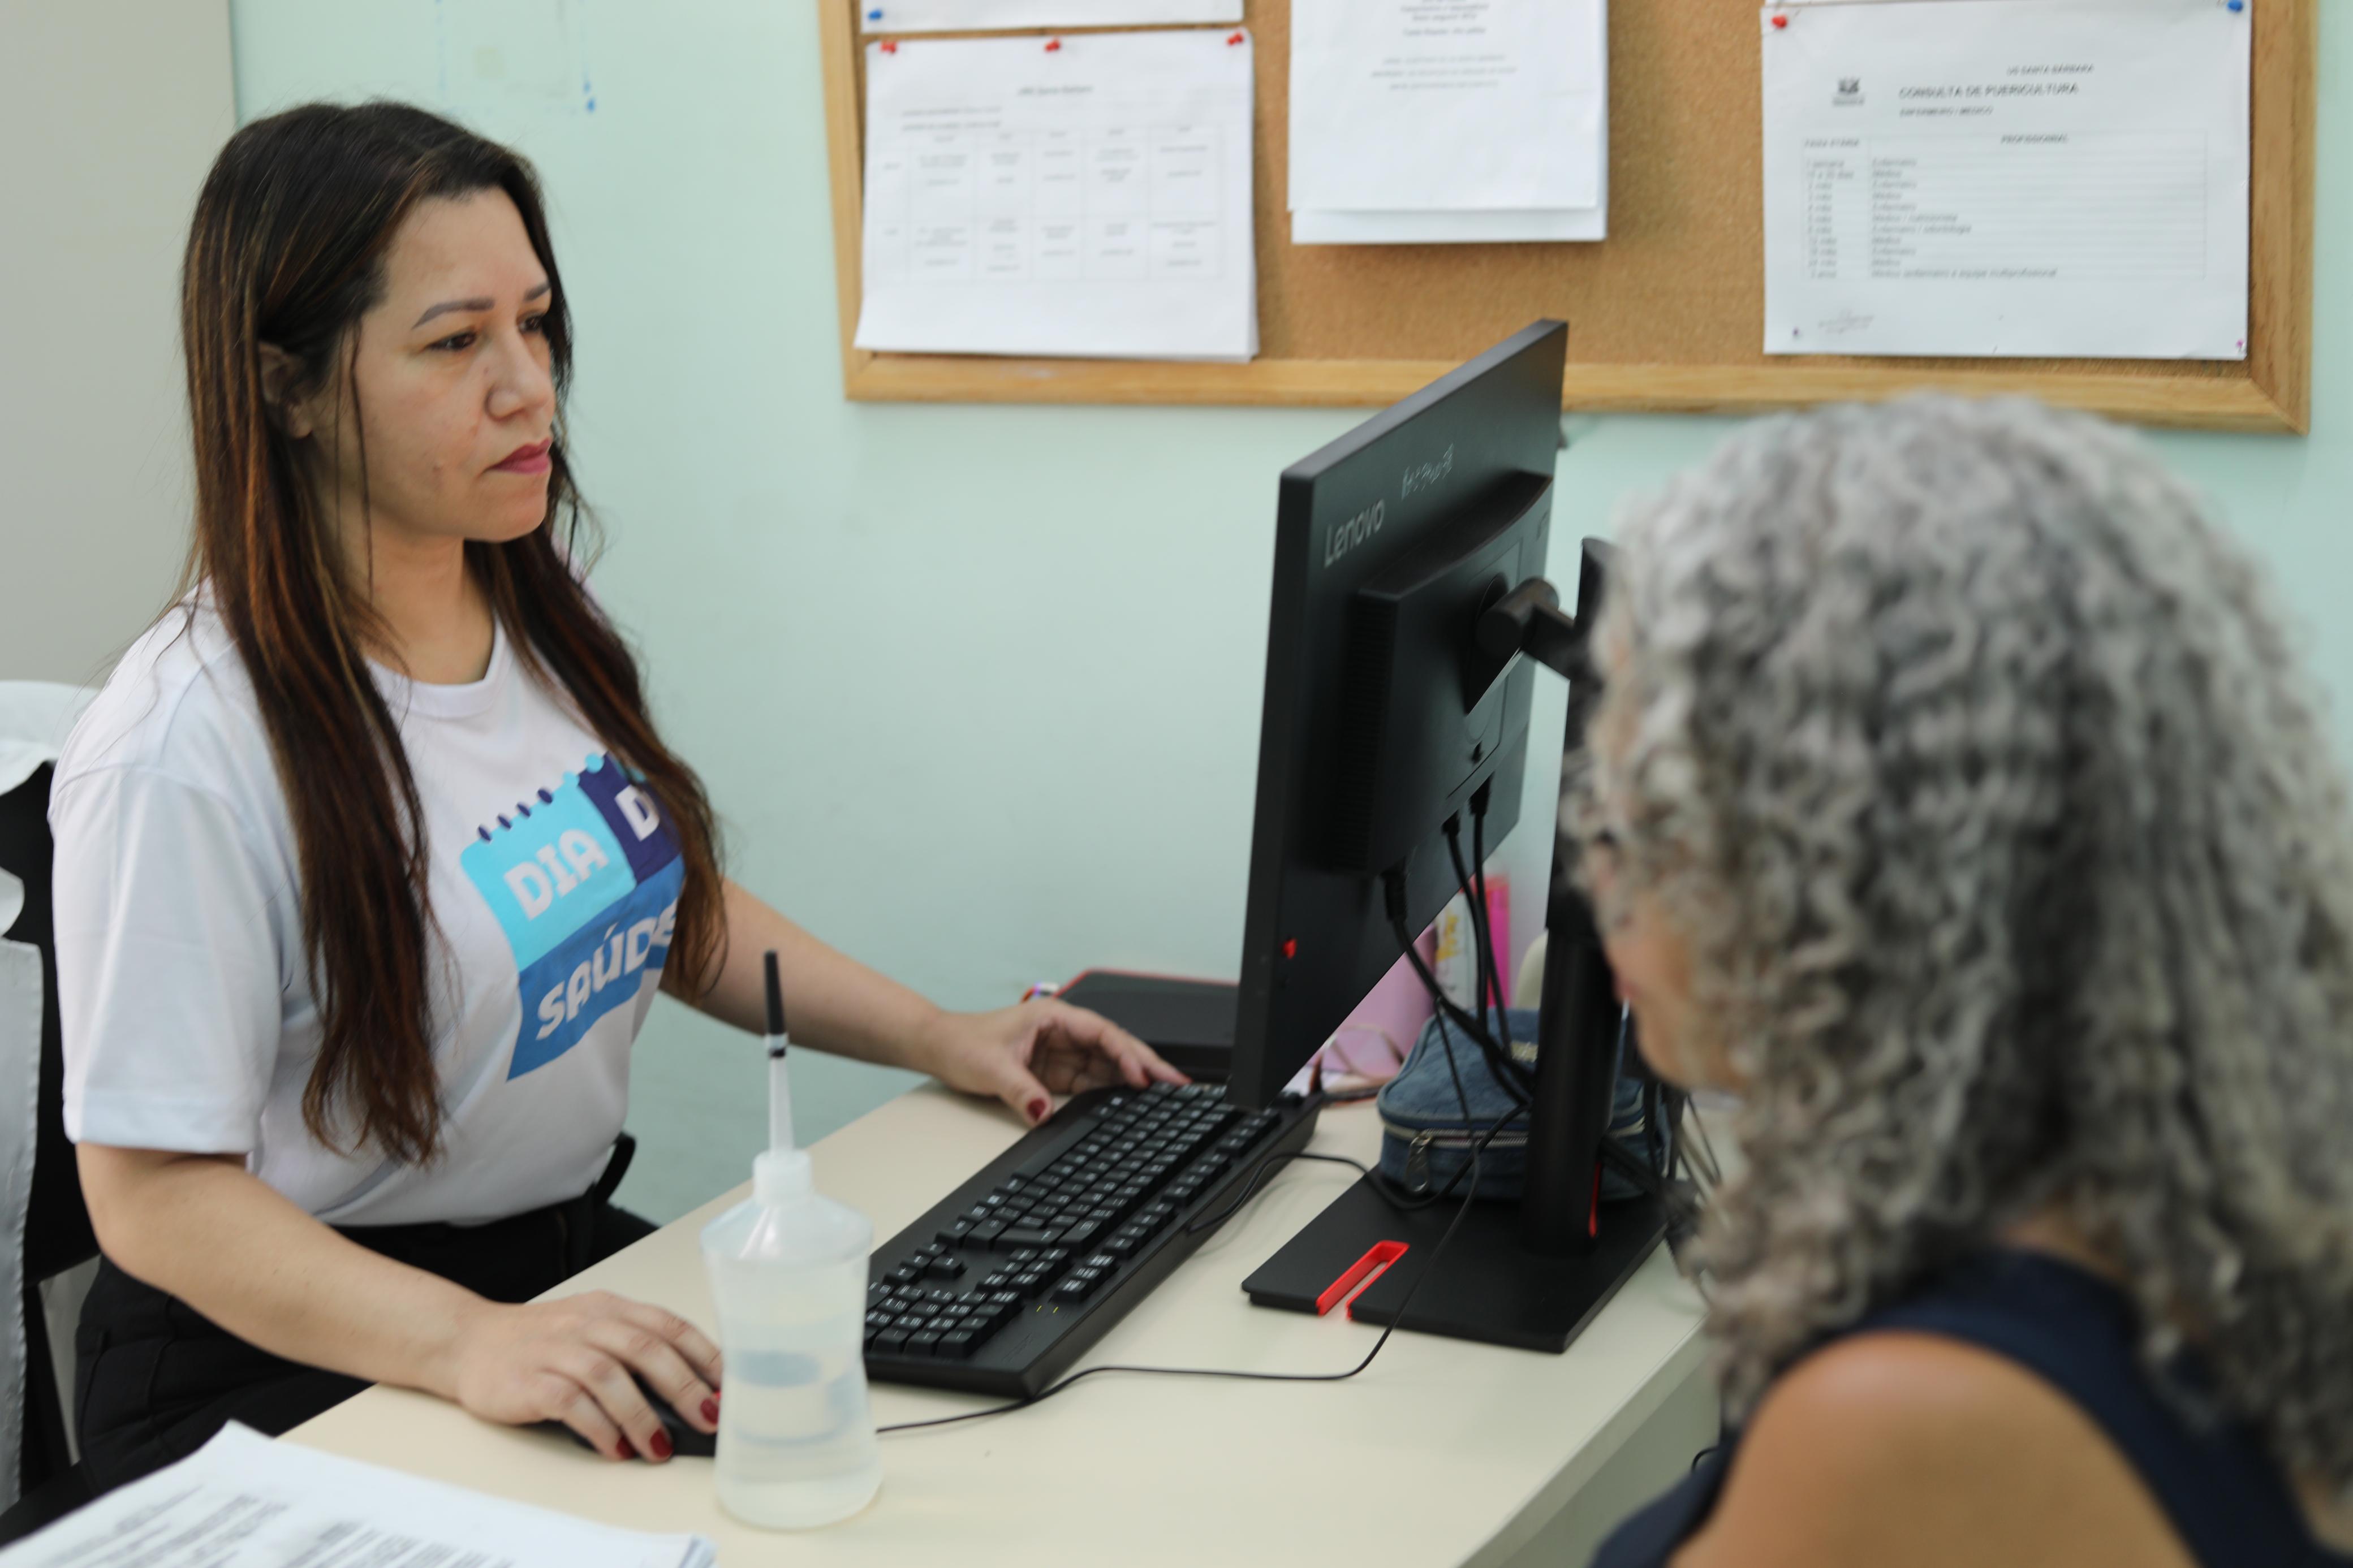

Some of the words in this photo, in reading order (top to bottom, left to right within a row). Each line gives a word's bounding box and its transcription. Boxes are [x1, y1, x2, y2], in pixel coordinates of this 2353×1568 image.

[1899, 85, 1962, 99] CONSULTA
[1966, 84, 1981, 98] DE
[1984, 82, 2080, 97] PUERICULTURA
[1324, 499, 1385, 568] Lenovo
[503, 828, 609, 921] DIA
[535, 896, 678, 1040] SAÚDE
